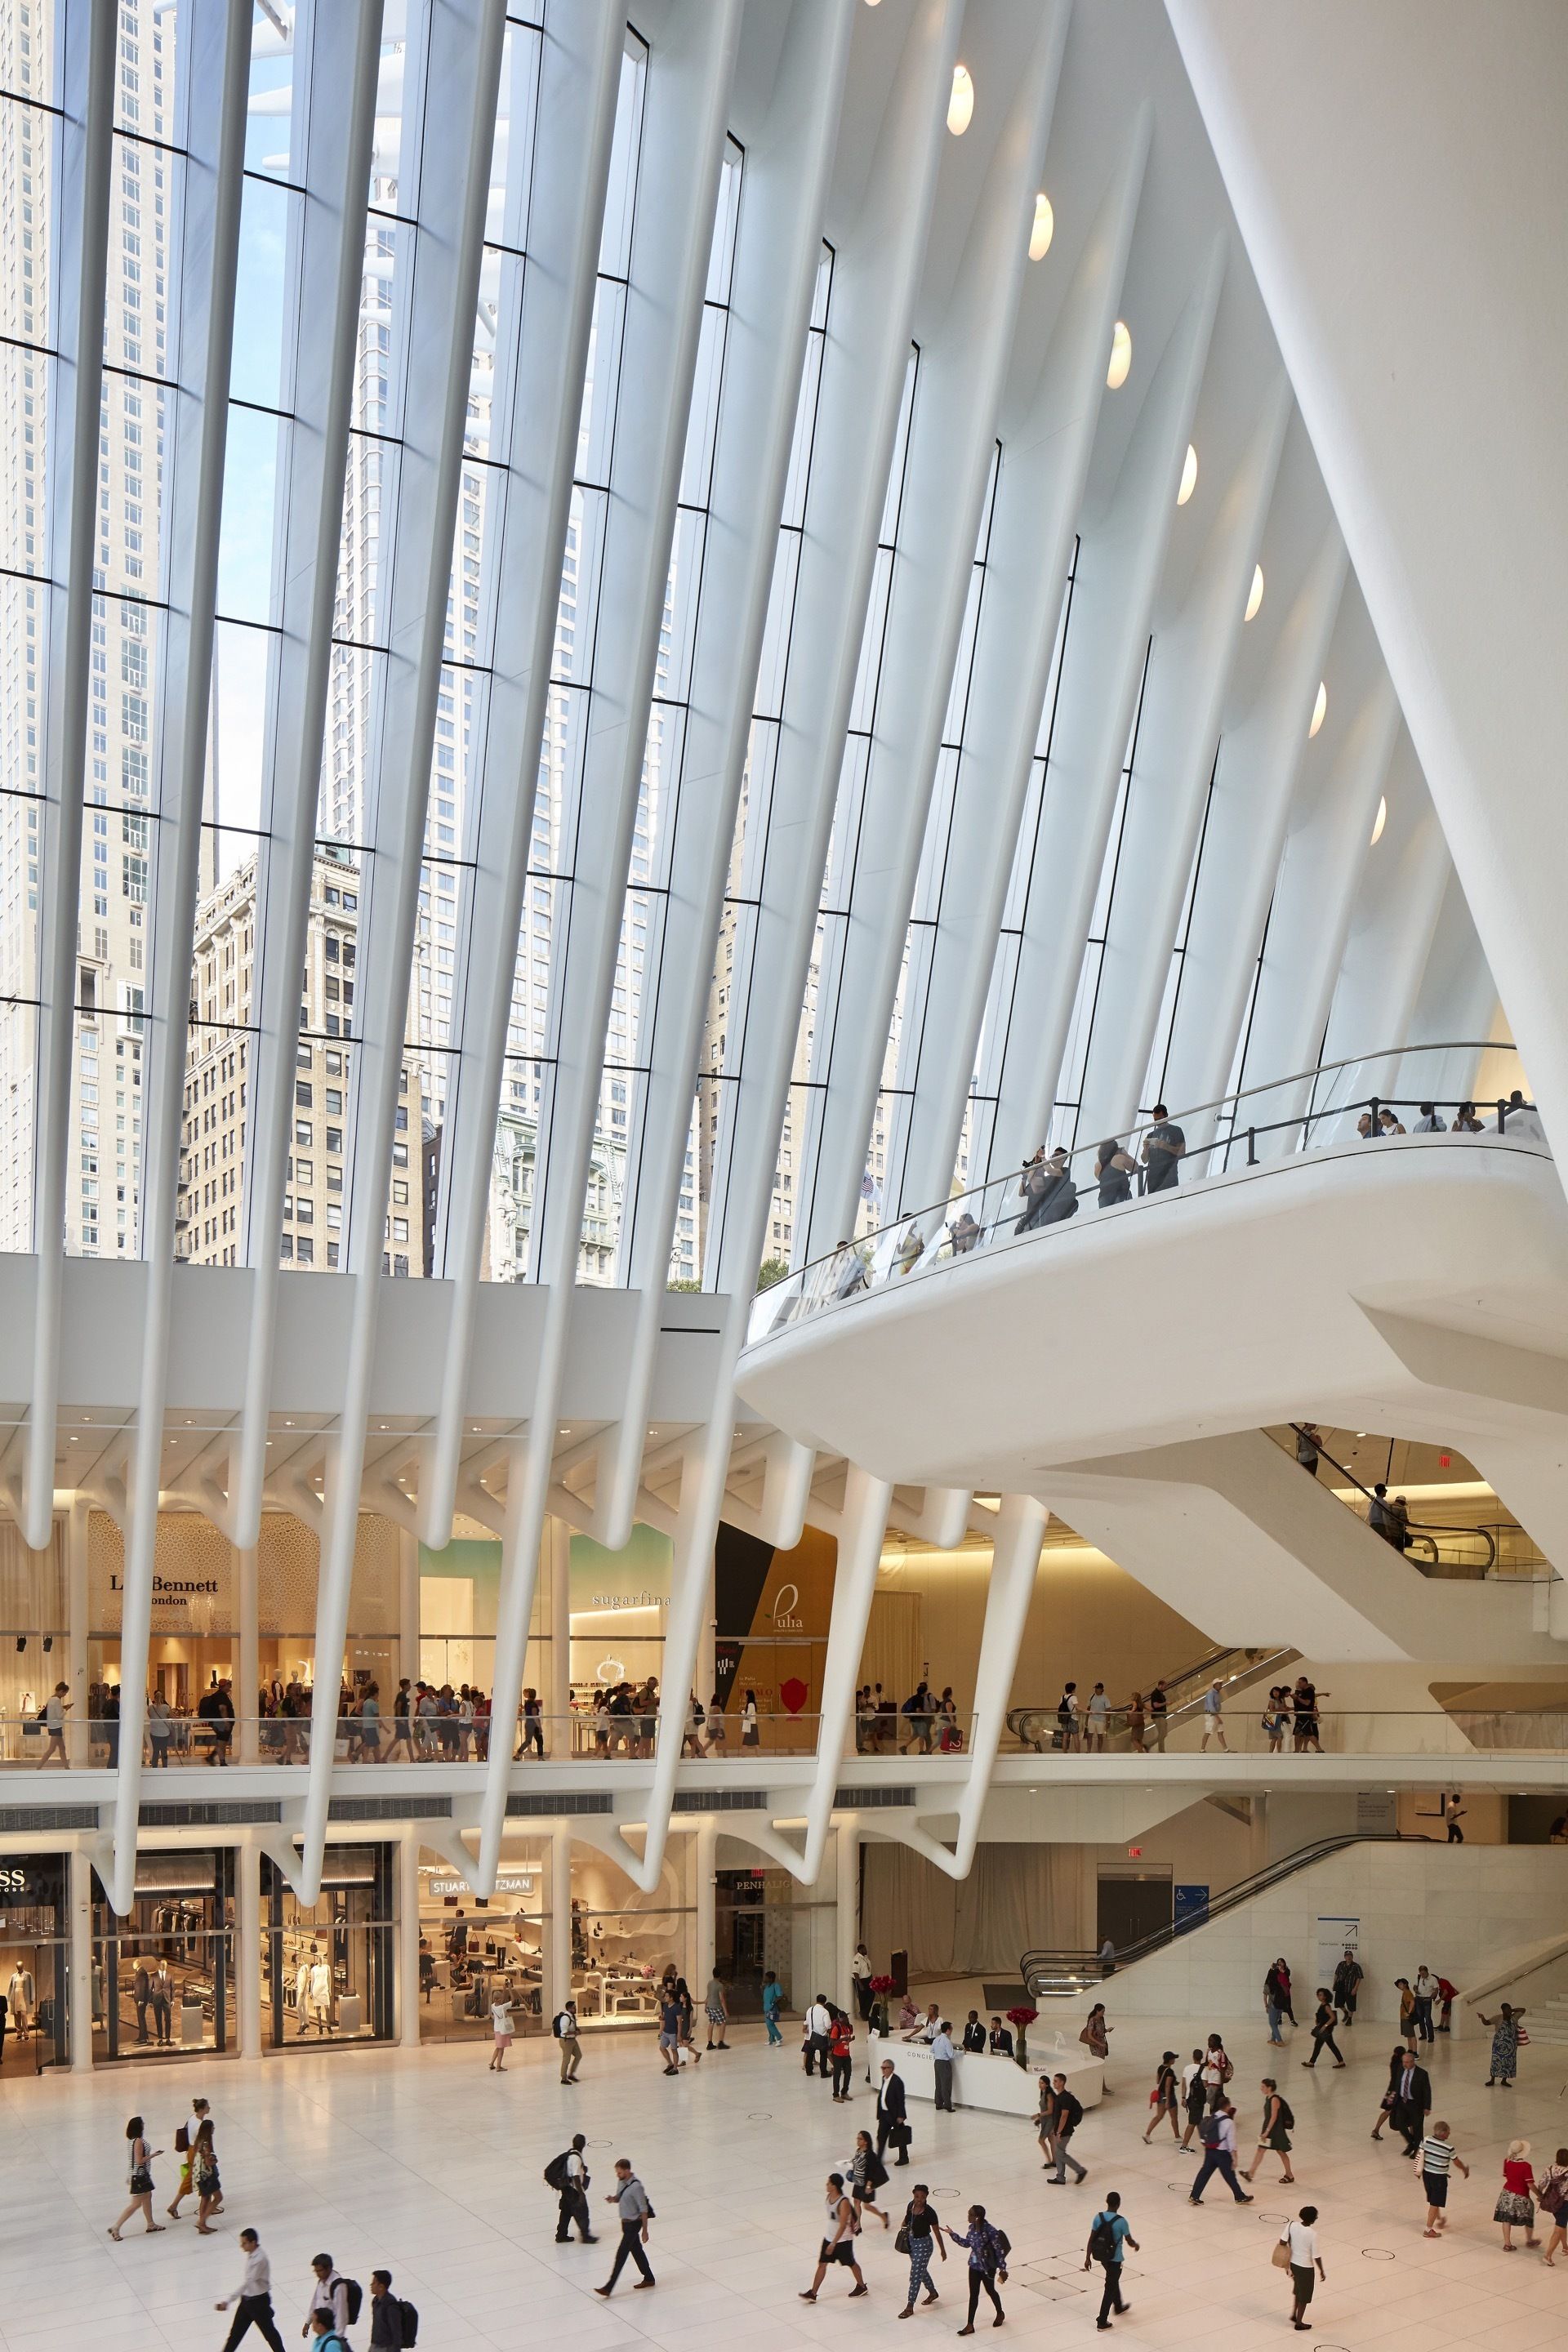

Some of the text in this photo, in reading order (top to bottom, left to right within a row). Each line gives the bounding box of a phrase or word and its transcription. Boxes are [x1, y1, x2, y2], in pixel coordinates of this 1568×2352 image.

[152, 1575, 218, 1592] Bennett
[151, 1594, 187, 1606] ondon
[592, 1590, 670, 1610] sugarfina
[495, 1879, 530, 1891] TZMAN
[736, 1880, 791, 1890] PENHALIG
